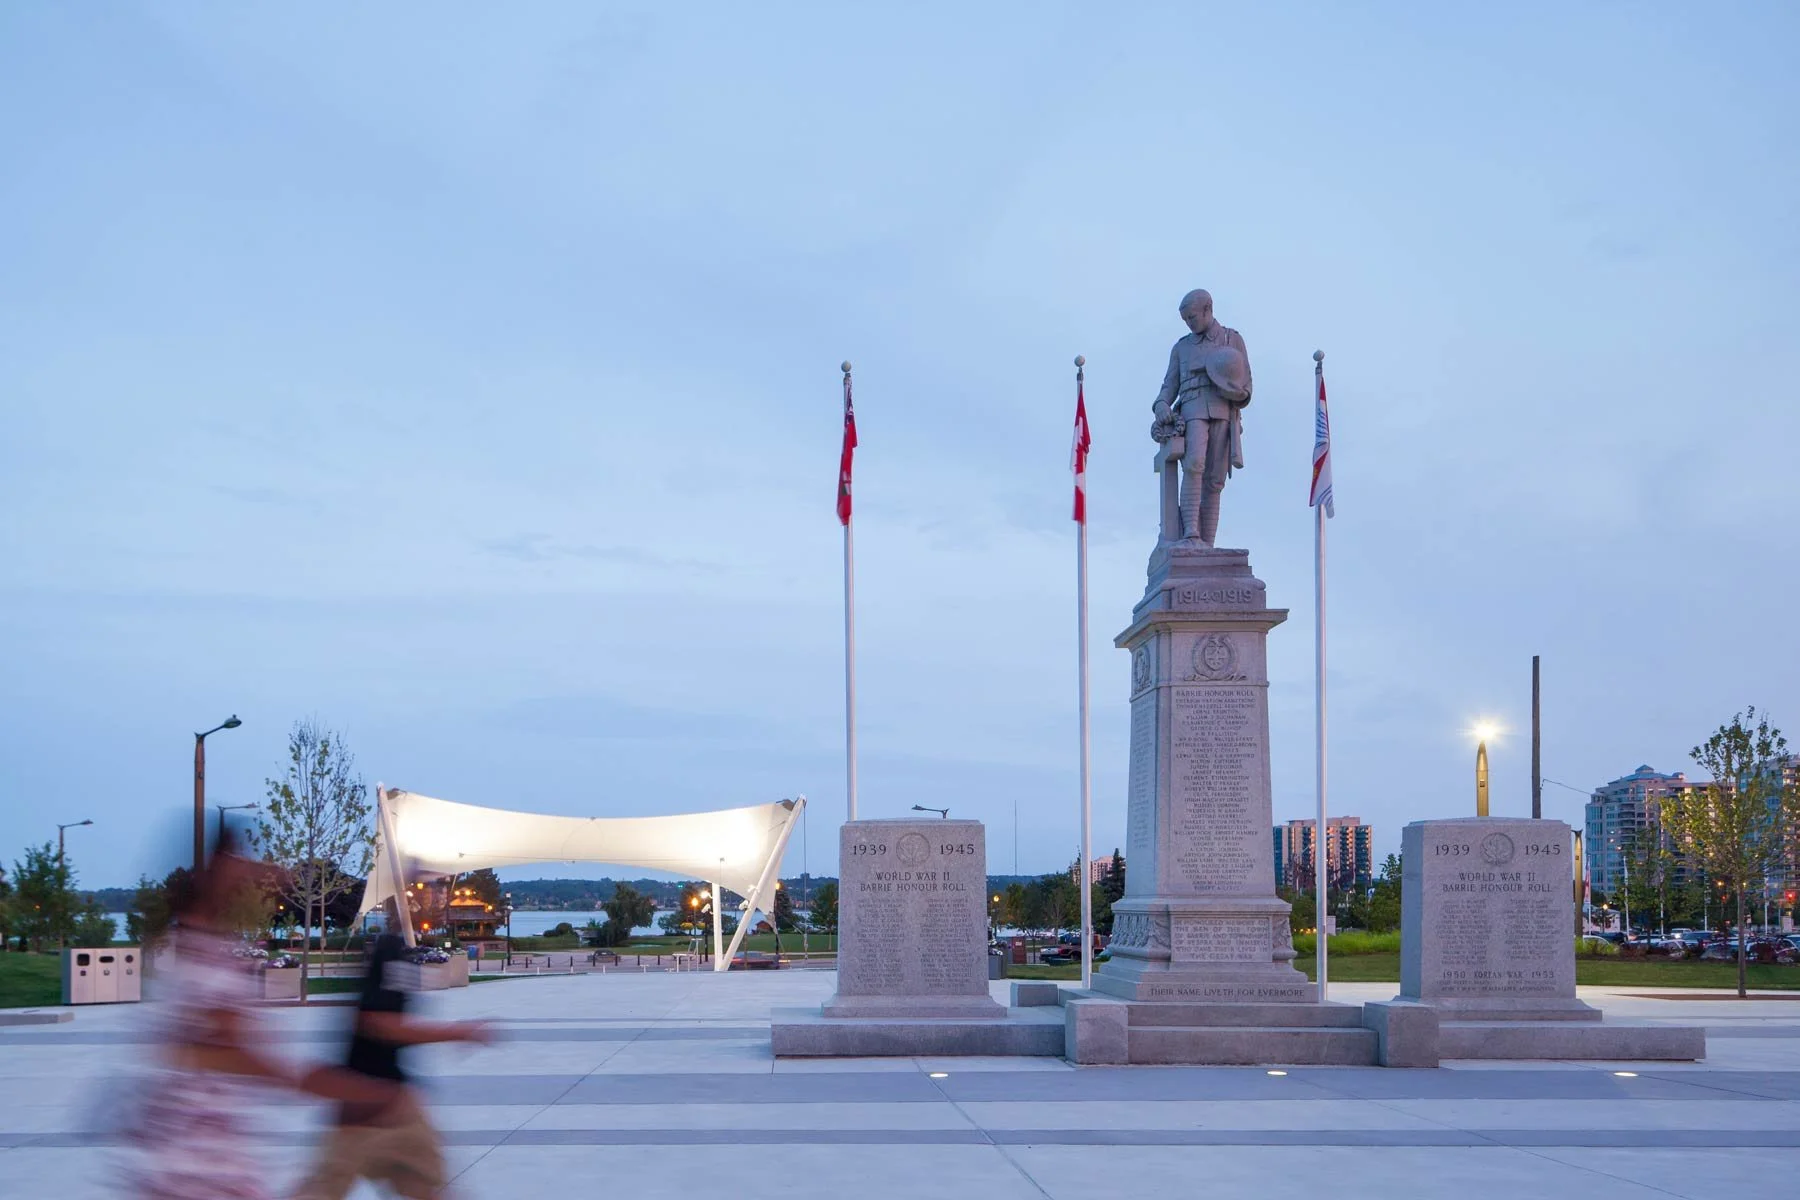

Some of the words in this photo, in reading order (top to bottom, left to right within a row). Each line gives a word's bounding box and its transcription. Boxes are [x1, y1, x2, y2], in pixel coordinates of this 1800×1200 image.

[1177, 590, 1210, 604] 1914
[853, 844, 887, 856] 1939
[940, 844, 975, 855] 1945
[1435, 844, 1470, 856] 1939
[1525, 844, 1561, 855] 1945
[875, 872, 911, 881] WORLD
[916, 872, 937, 881] WAR
[943, 872, 950, 881] II
[1459, 872, 1495, 882] WORLD
[1500, 872, 1521, 882] WAR
[1527, 872, 1536, 882] II
[860, 883, 892, 891] BARRIE
[897, 883, 938, 891] HONOUR
[943, 883, 966, 891] ROLL
[1443, 884, 1475, 893] BARRIE
[1481, 884, 1522, 893] HONOUR
[1528, 884, 1553, 893] ROLL
[1443, 971, 1466, 979] 1950
[1474, 971, 1502, 979] KOREAN
[1507, 971, 1523, 979] WAR
[1531, 971, 1555, 979] 1953
[1150, 988, 1173, 997] THEIR
[1177, 988, 1200, 997] NAME
[1204, 988, 1234, 997] LIVETH
[1237, 988, 1254, 997] FOR
[1258, 988, 1305, 997] EVERMORE
